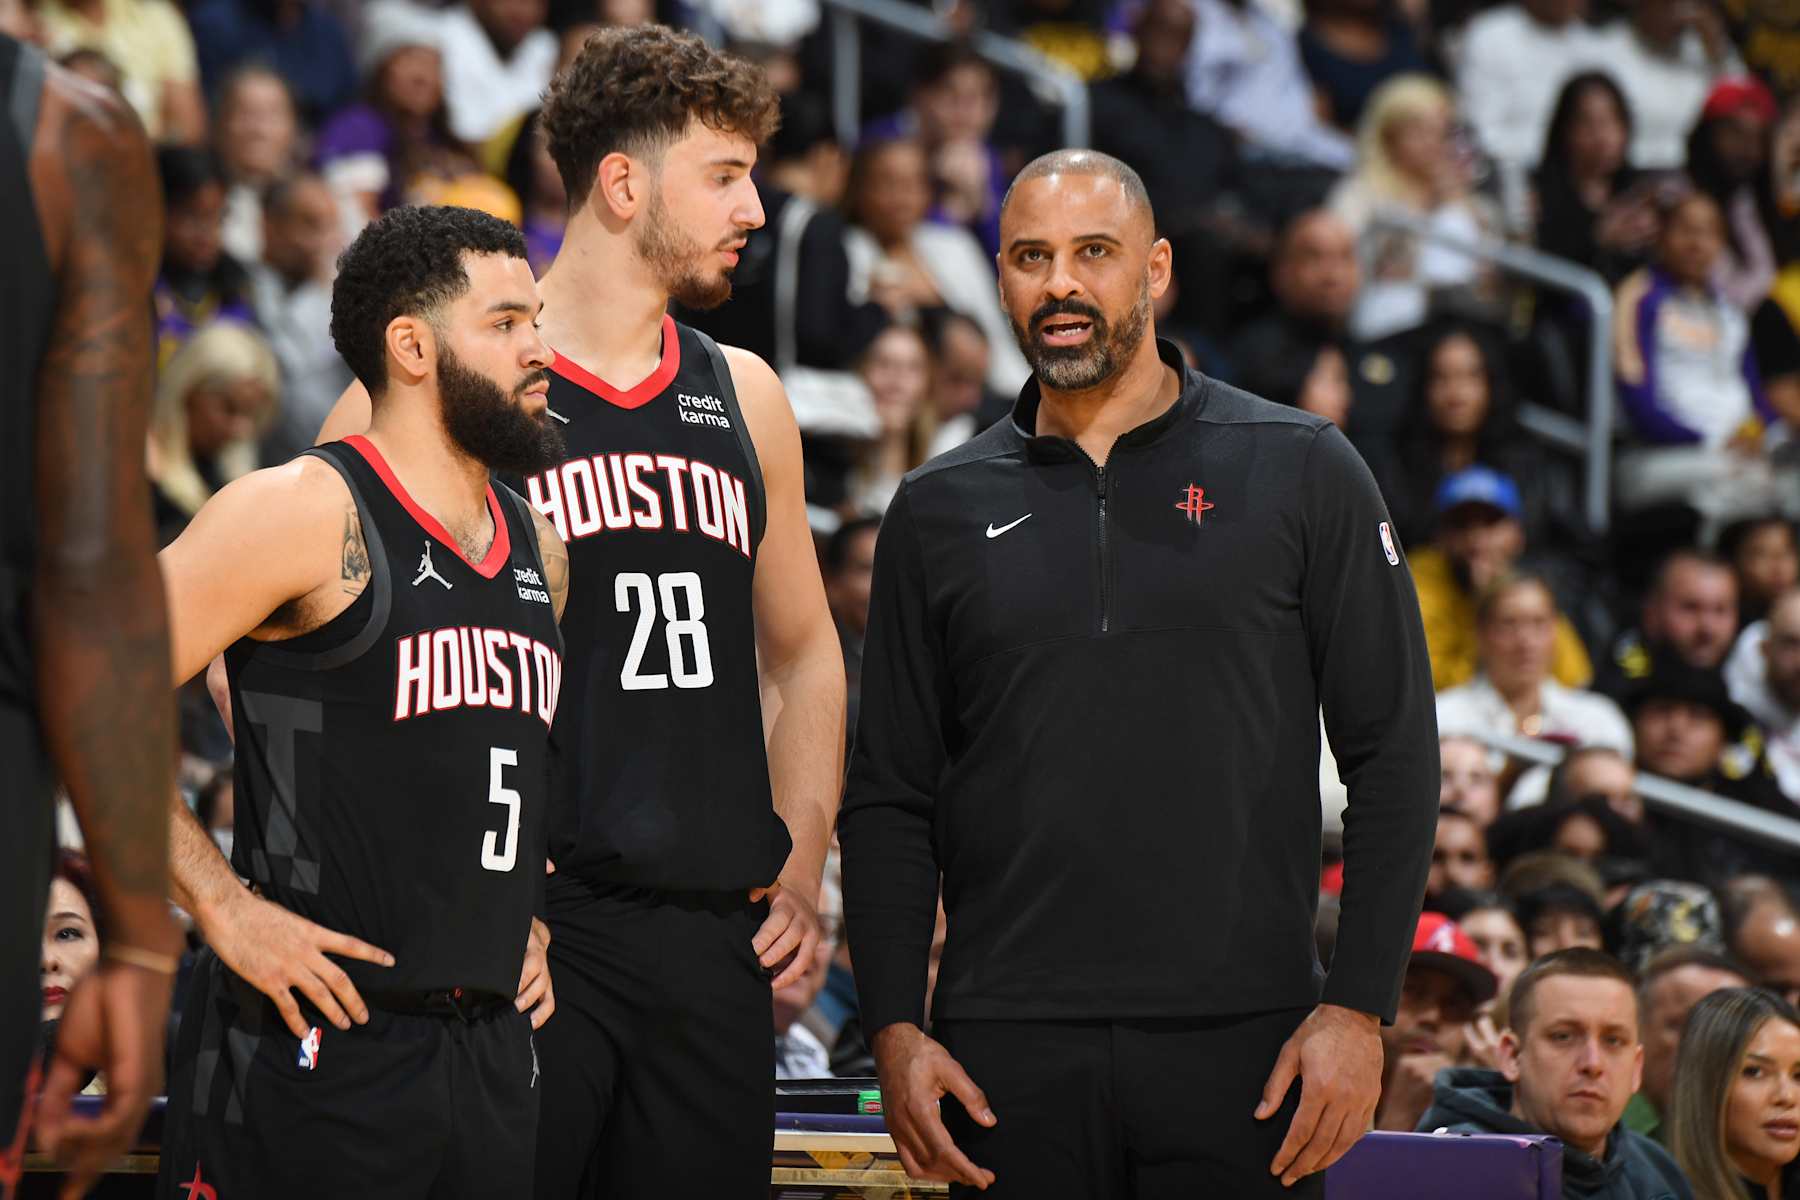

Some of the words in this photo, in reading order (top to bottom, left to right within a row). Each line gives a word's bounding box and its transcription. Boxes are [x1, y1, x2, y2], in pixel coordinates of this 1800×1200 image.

[678, 393, 725, 412] credit
[678, 405, 731, 429] karma
[526, 453, 751, 559] HOUSTON
[614, 571, 714, 691] 28
[480, 746, 522, 873] 5
